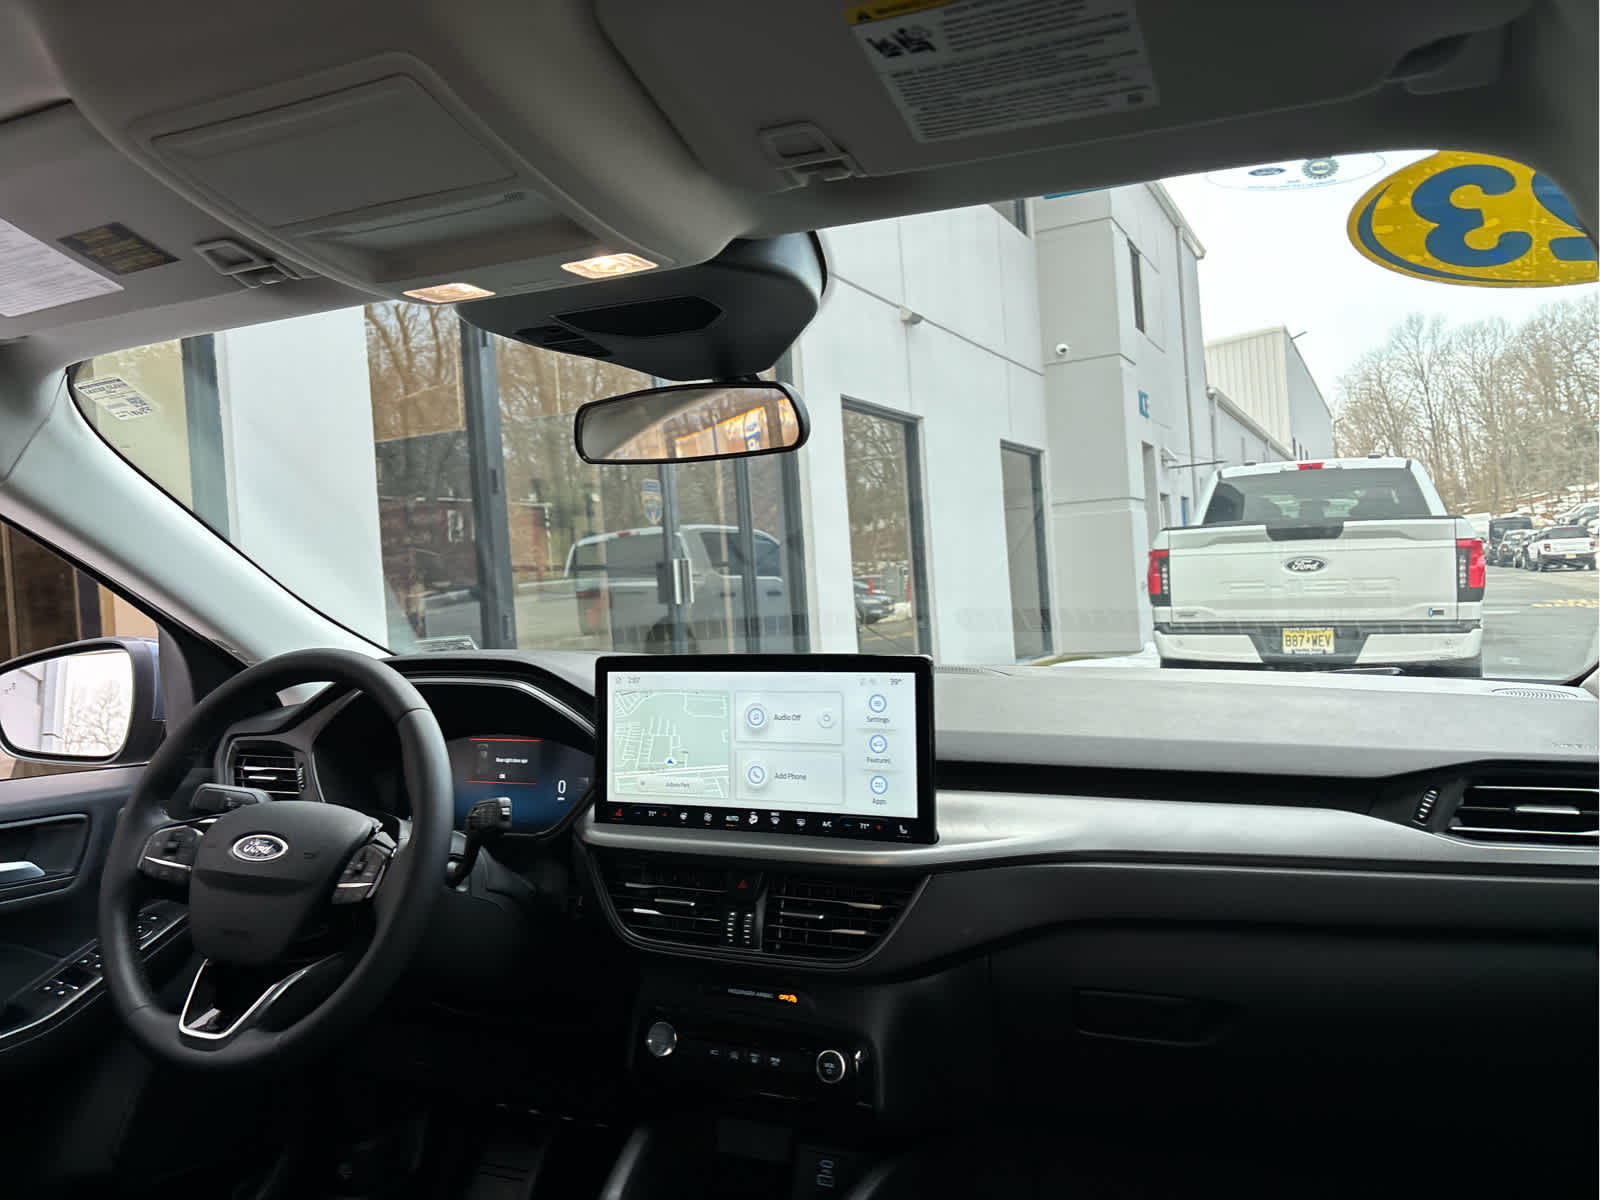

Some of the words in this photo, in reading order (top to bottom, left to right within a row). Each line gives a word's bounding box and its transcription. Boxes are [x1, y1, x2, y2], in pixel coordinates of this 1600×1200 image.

[773, 713, 790, 721] Audio
[791, 713, 801, 721] Off
[866, 715, 890, 724] Settings
[866, 756, 891, 764] Features
[774, 772, 786, 780] Add
[787, 773, 807, 781] Phone
[557, 780, 567, 794] 0
[872, 797, 887, 806] Apps
[240, 837, 277, 857] Ford
